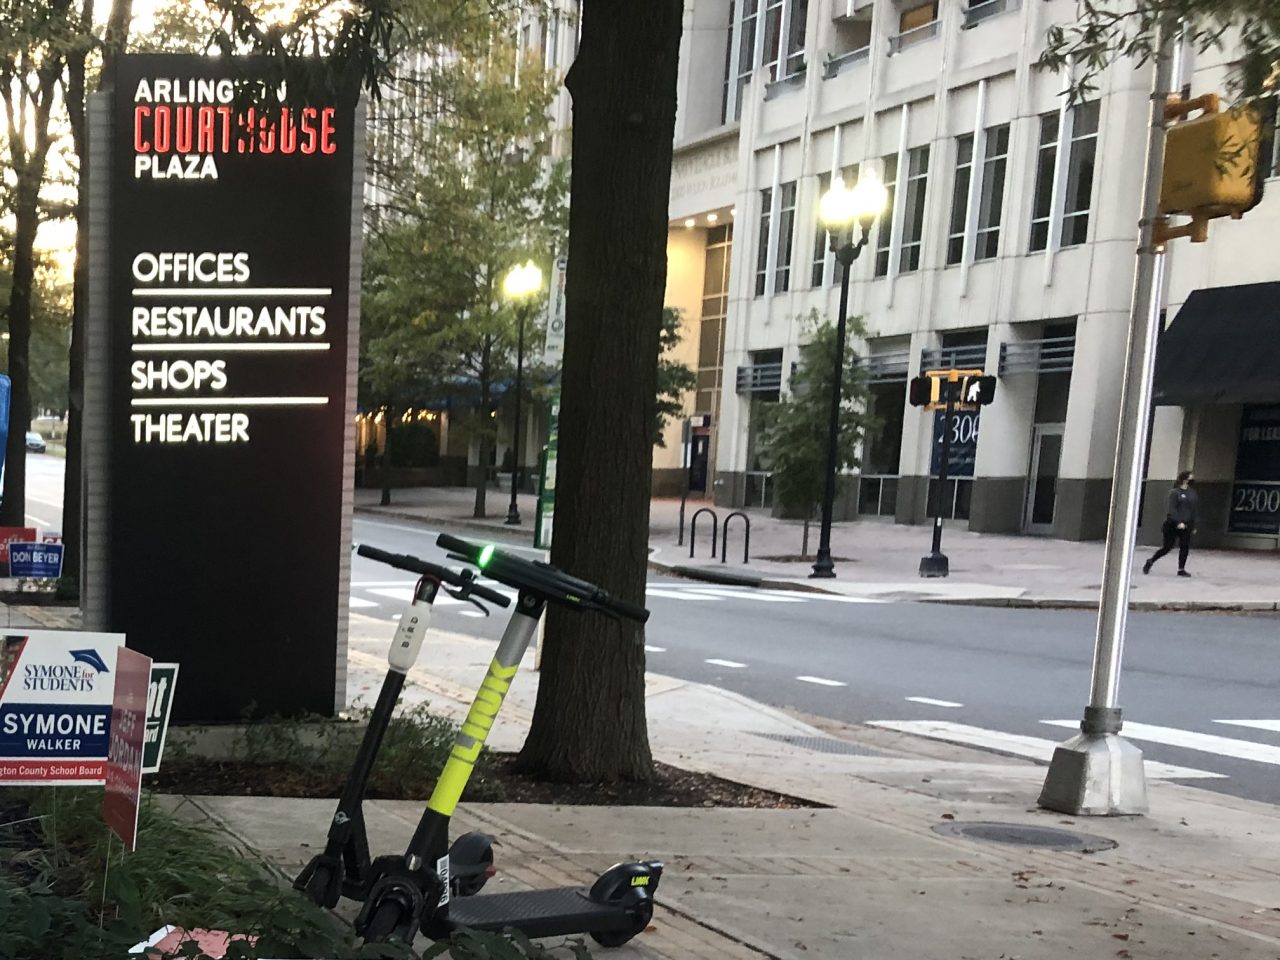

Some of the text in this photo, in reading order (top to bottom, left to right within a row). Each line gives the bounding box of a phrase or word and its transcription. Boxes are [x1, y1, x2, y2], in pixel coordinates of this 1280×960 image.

[134, 79, 287, 103] ARLINGN
[134, 154, 219, 179] PLAZA
[132, 252, 250, 282] OFFICES
[132, 306, 326, 336] RESTAURANTS
[131, 360, 227, 390] SHOPS
[130, 413, 250, 442] THEATER
[1235, 489, 1280, 512] 2300
[12, 552, 30, 562] DON
[24, 664, 94, 678] SYMONE for
[23, 679, 94, 691] STUDENTS
[3, 713, 106, 735] SYMONE
[26, 738, 81, 750] WALKER
[19, 766, 48, 777] County
[50, 766, 78, 775] School
[79, 766, 103, 775] Board
